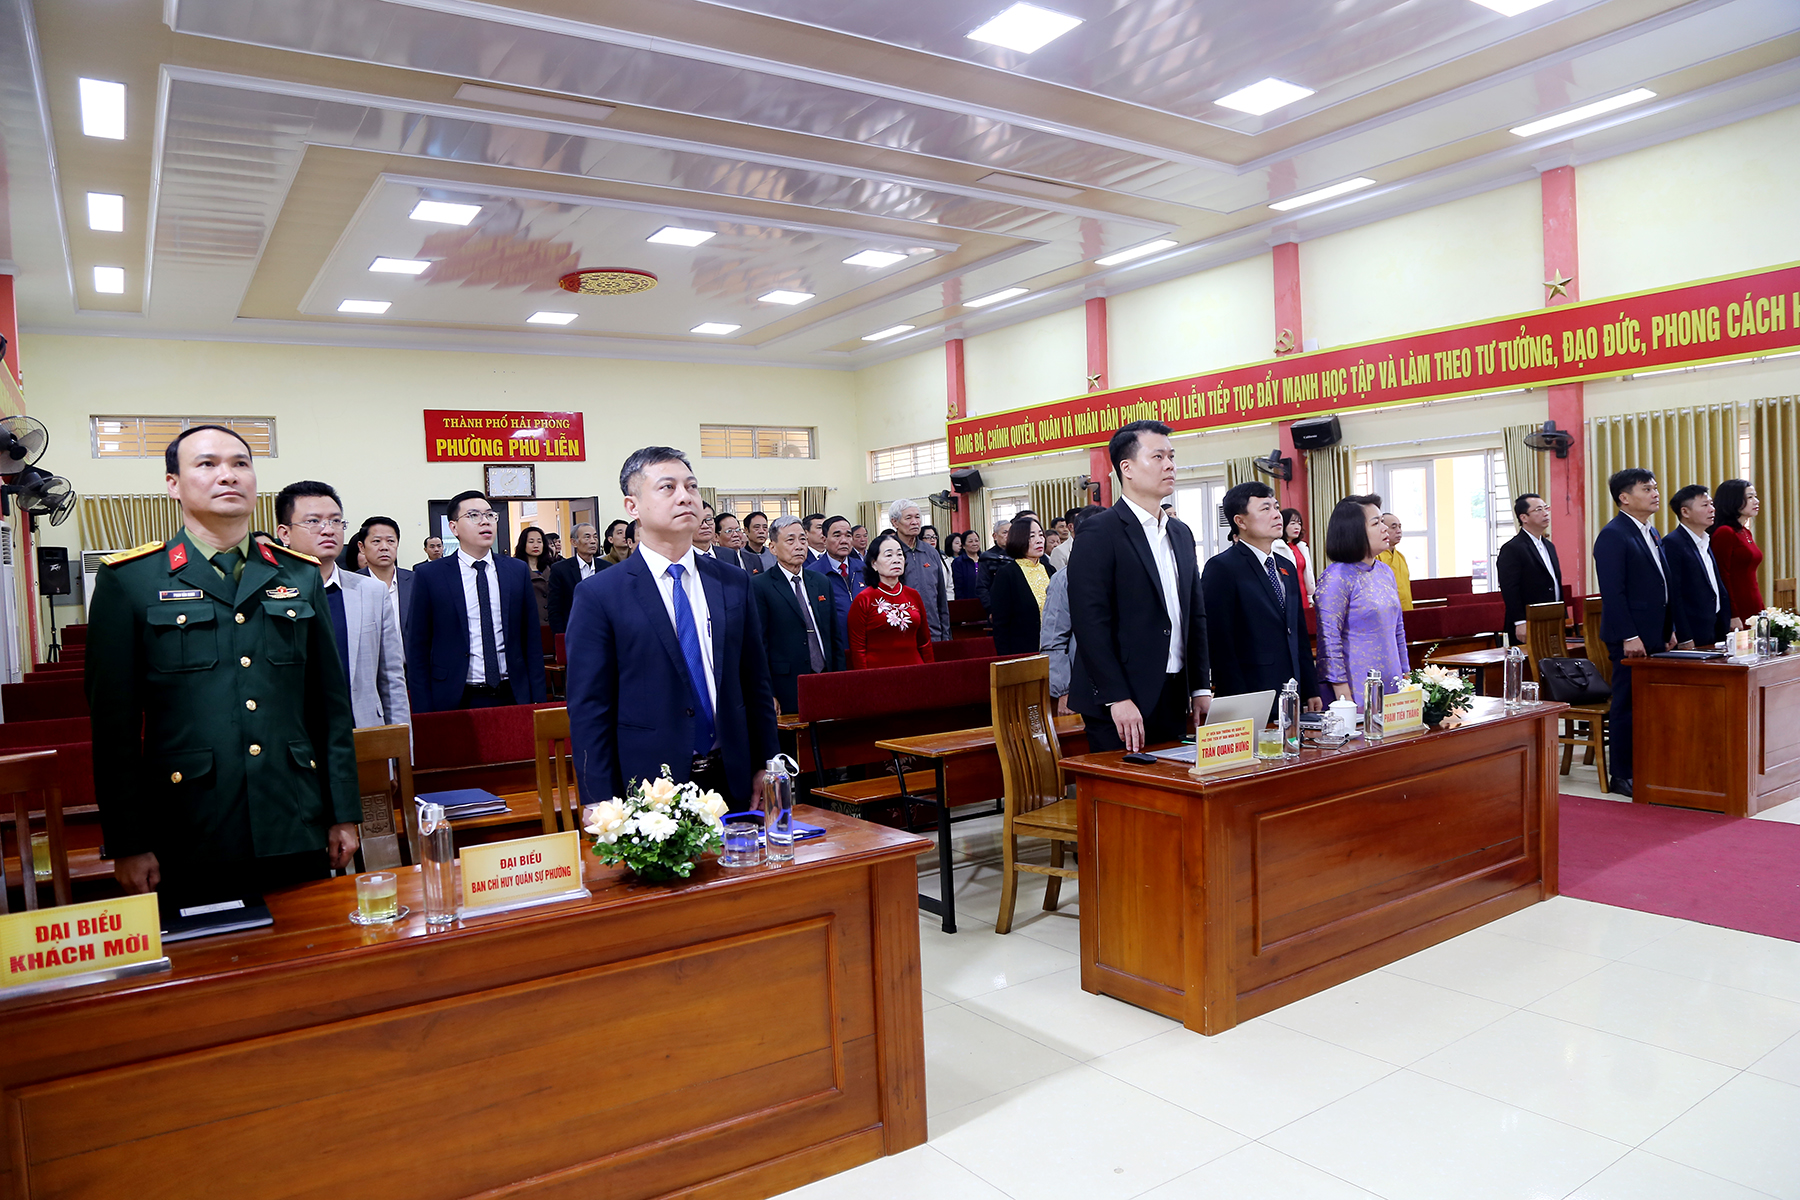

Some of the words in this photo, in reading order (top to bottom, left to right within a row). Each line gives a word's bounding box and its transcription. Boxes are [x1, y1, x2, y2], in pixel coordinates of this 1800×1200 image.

[954, 427, 974, 456] ĐẢNG
[974, 428, 987, 457] BỘ,
[987, 421, 1010, 450] CHÍNH
[1010, 415, 1038, 449] QUYỀN,
[1038, 414, 1061, 444] QUÂN
[1061, 411, 1073, 439] VÀ
[1074, 407, 1099, 436] NHÂN
[1100, 404, 1119, 432] DÂN
[1120, 397, 1159, 427] PHƯỜNG
[1160, 392, 1180, 422] PHÙ
[1182, 384, 1206, 419] LIỄN
[1208, 380, 1231, 415] TIẾP
[1233, 383, 1254, 416] TỤC
[1256, 370, 1280, 408] ĐẨY
[1282, 372, 1319, 408] MẠNH
[1322, 367, 1348, 403] HỌC
[1350, 359, 1376, 399] TẬP
[1378, 354, 1398, 389] VÀ
[1400, 350, 1431, 386] LÀM
[1434, 347, 1472, 382] THEO
[1475, 339, 1496, 376] TƯ
[1499, 324, 1559, 373] TƯỞNG,
[1562, 326, 1599, 369] ĐẠO
[1603, 311, 1647, 357] ĐỨC,
[1651, 306, 1721, 350] PHONG
[1726, 292, 1786, 339] CÁCH
[443, 415, 482, 428] THÀNH
[485, 414, 508, 428] PHỐ
[511, 416, 531, 428] HẢI
[534, 416, 570, 429] PHÒNG
[436, 434, 503, 456] PHƯỜNG
[509, 436, 540, 456] PHÙ
[546, 433, 580, 456] LIỄN
[500, 858, 517, 870] ĐẠI
[520, 850, 542, 866] BIỂU
[471, 880, 486, 893] BAN
[487, 875, 499, 891] CHỈ
[500, 876, 513, 889] HUY
[515, 871, 533, 886] QUÂN
[534, 869, 545, 884] SỰ
[545, 864, 571, 880] PHƯỜNG
[35, 922, 70, 944] ĐẠI
[77, 909, 122, 937] BIỂU
[9, 943, 95, 974] KHÁCH
[103, 933, 150, 958] MỜI
